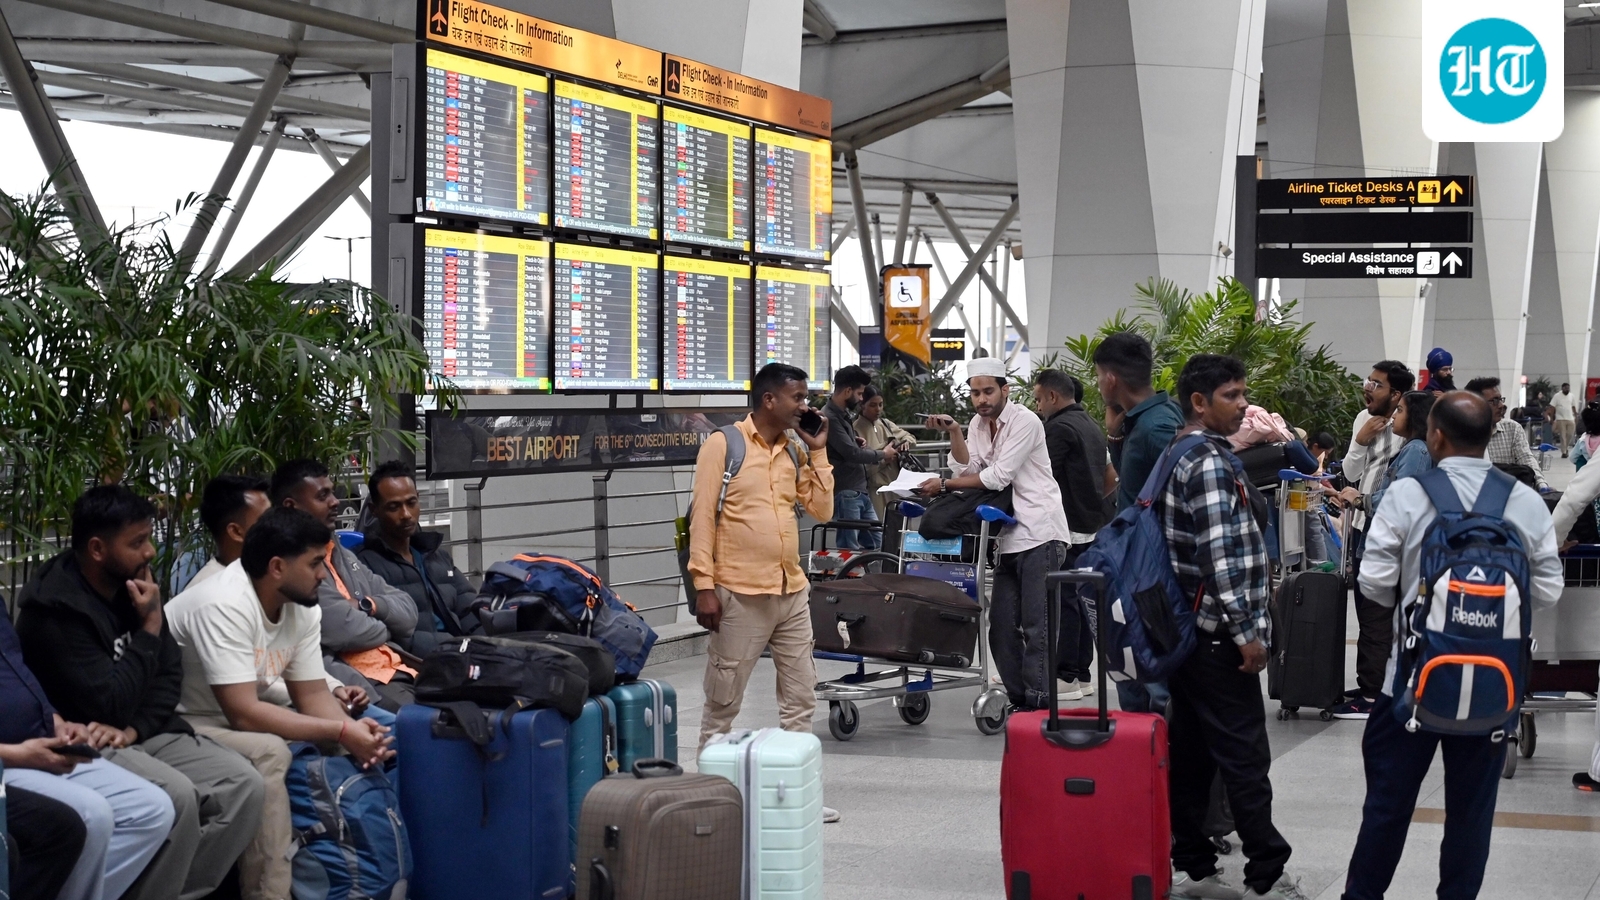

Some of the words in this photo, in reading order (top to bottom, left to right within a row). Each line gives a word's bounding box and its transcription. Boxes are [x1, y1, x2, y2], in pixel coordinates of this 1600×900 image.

[452, 1, 478, 24] Flight
[480, 9, 508, 30] Check
[516, 18, 524, 34] In
[526, 21, 573, 48] Information
[682, 64, 701, 82] Flight
[702, 70, 722, 87] Check
[727, 76, 733, 90] In
[734, 78, 768, 99] Information
[1288, 183, 1324, 193] Airline
[1328, 182, 1362, 193] Ticket
[1366, 181, 1403, 192] Desks
[1406, 181, 1415, 192] A
[1320, 197, 1353, 206] एयरलाइन
[1356, 195, 1376, 204] टिकट
[1379, 195, 1396, 204] डेस्क
[1302, 252, 1345, 265] Special
[1348, 252, 1414, 263] Assistance
[1366, 265, 1385, 274] विशेष
[1388, 267, 1414, 276] सहायक
[487, 436, 522, 462] BEST
[524, 435, 580, 460] AIRPORT
[594, 436, 609, 449] FOR
[611, 435, 624, 448] THE
[635, 433, 679, 448] CONSECUTIVE
[680, 432, 697, 446] YEAR
[1452, 606, 1497, 628] Reebok
